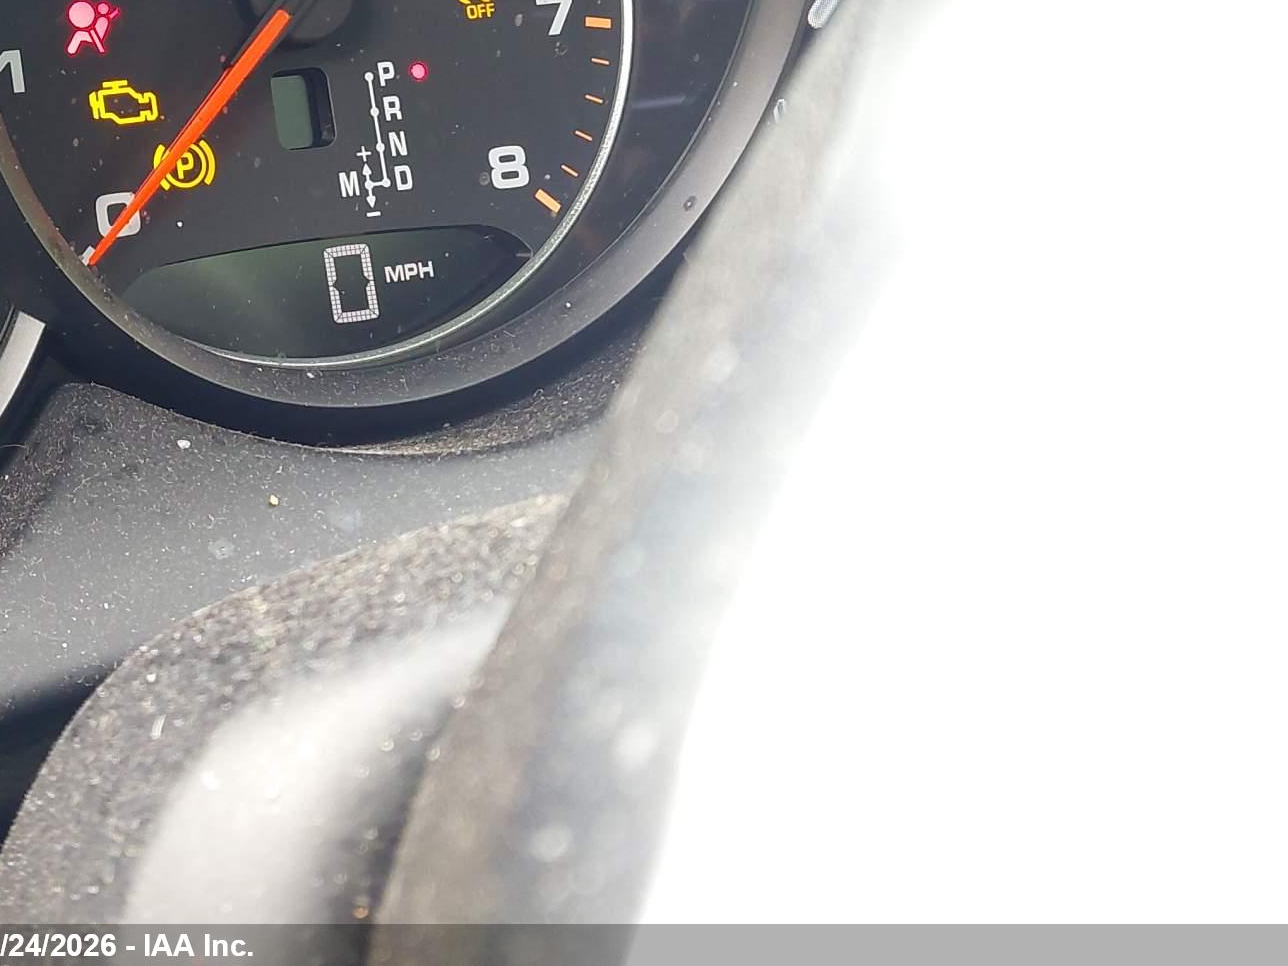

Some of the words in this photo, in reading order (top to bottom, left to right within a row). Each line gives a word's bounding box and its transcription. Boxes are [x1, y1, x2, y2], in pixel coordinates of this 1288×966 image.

[466, 3, 496, 20] OFF
[378, 62, 397, 87] P
[384, 95, 403, 122] R
[390, 130, 409, 157] N
[394, 164, 414, 191] D
[488, 146, 530, 187] 8
[339, 170, 362, 198] M
[95, 192, 141, 237] 0
[323, 243, 380, 324] 0
[384, 261, 435, 284] MPH
